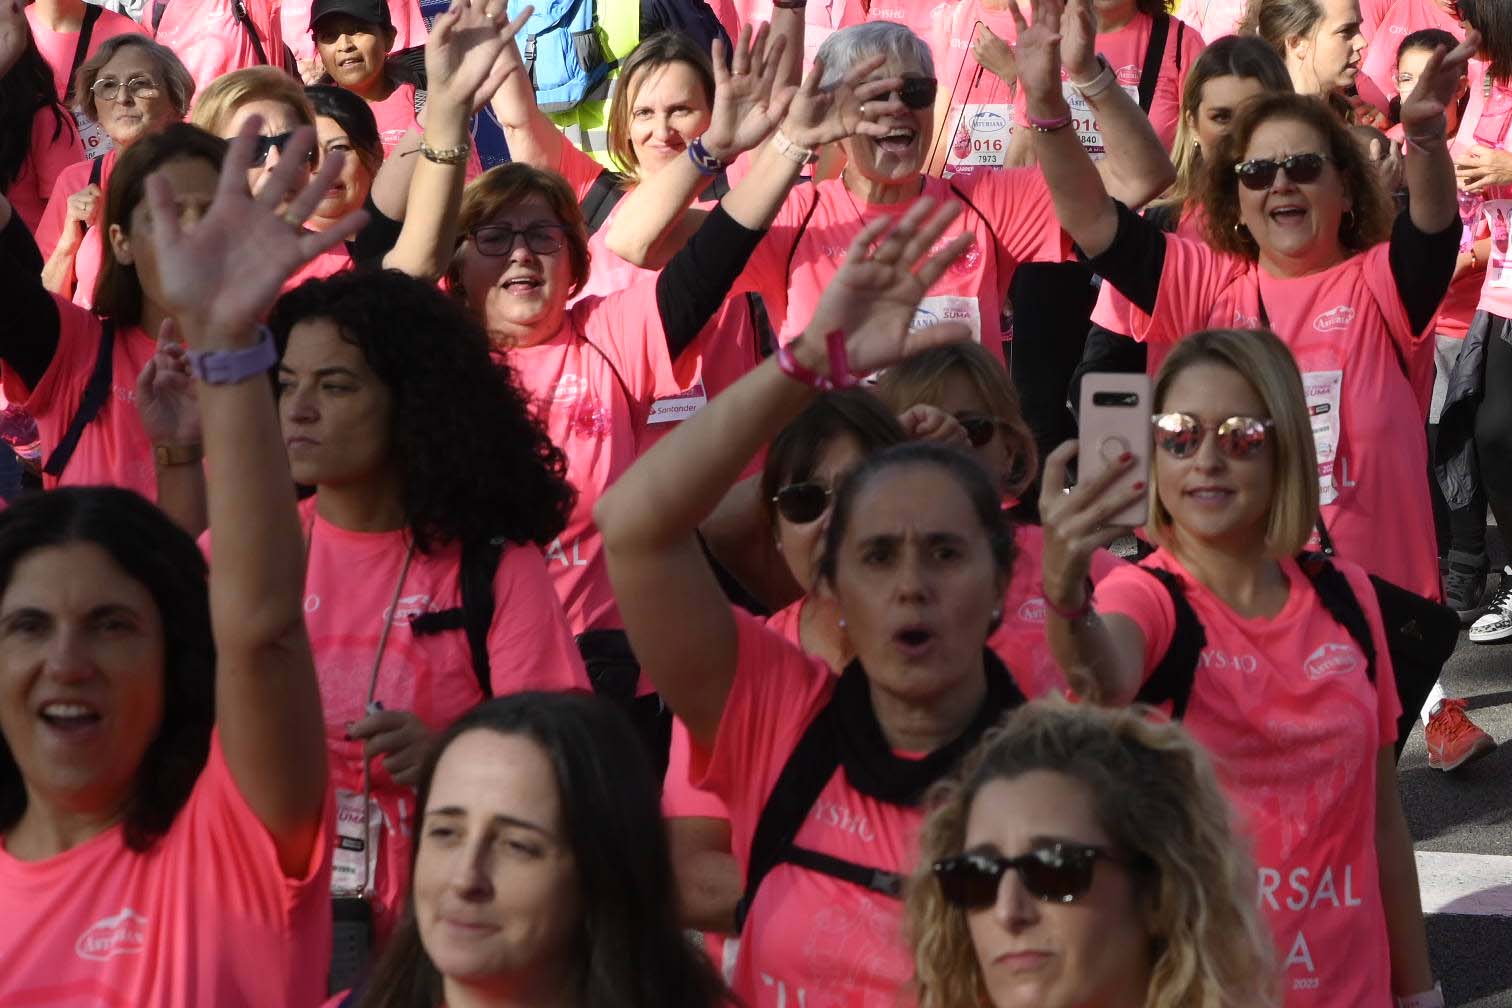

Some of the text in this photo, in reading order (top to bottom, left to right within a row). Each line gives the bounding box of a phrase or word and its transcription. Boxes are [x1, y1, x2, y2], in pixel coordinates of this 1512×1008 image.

[1079, 135, 1097, 144] 840
[974, 139, 1003, 152] 016
[978, 155, 997, 163] 7973
[943, 311, 971, 319] SUMA
[657, 404, 697, 414] Santander
